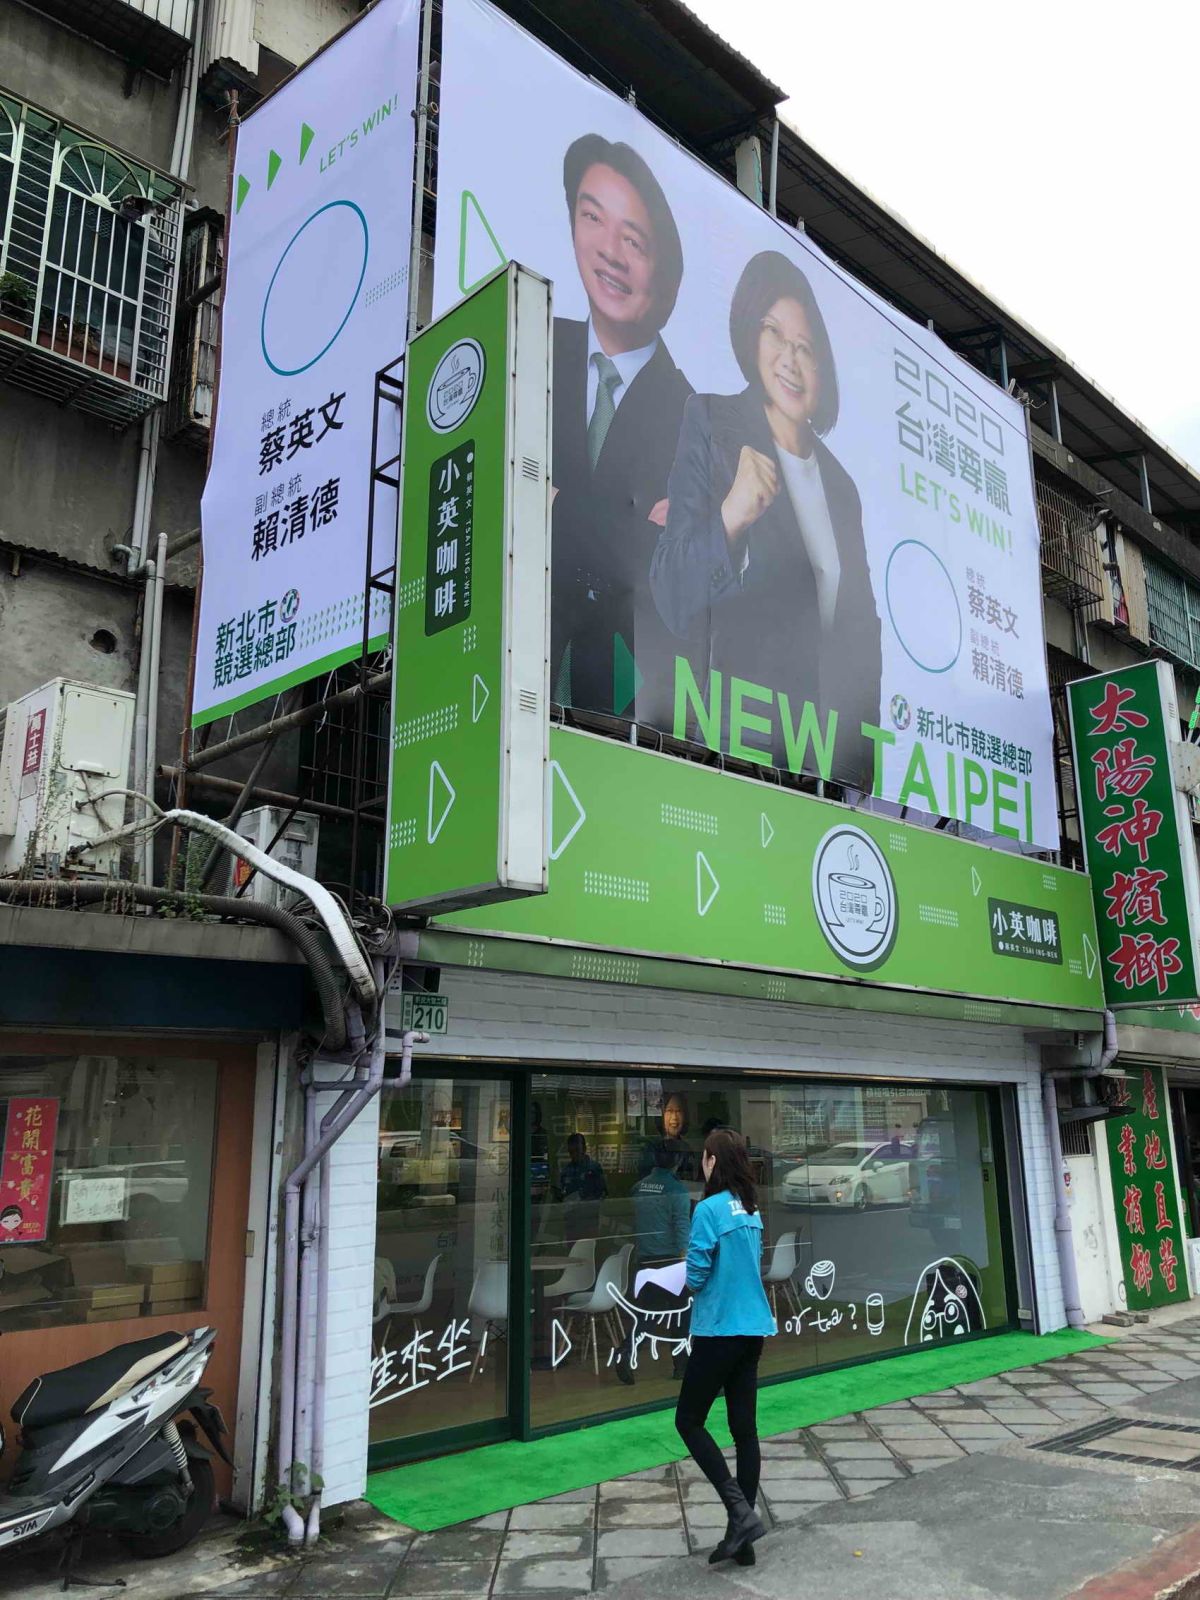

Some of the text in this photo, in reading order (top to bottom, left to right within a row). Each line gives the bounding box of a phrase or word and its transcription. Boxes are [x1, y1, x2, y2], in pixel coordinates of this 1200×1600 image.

[319, 94, 398, 173] LET'S WIN!
[259, 392, 346, 476] 蔡英文
[261, 398, 291, 432] 總統
[894, 347, 1004, 456] 2020
[255, 473, 302, 517] 副總統
[895, 401, 1012, 516] 台灣要贏
[252, 477, 340, 562] 賴清德
[434, 459, 460, 617] 小英咖啡
[900, 462, 1013, 556] LET'S WIN!
[216, 599, 278, 656] 新北市
[967, 585, 1020, 639] 蔡英文
[213, 622, 297, 690] 競選總部
[971, 648, 1024, 700] 賴清德
[673, 655, 839, 781] NEW
[916, 707, 1033, 776] 新北市競選總部
[861, 721, 1033, 843] TAIPEI
[1088, 682, 1183, 995] 太陽神檳榔
[993, 907, 1058, 946] 小英咖啡
[414, 1008, 444, 1030] 210
[16, 1105, 42, 1202] 花開富貴
[13, 1520, 38, 1537] SYM
